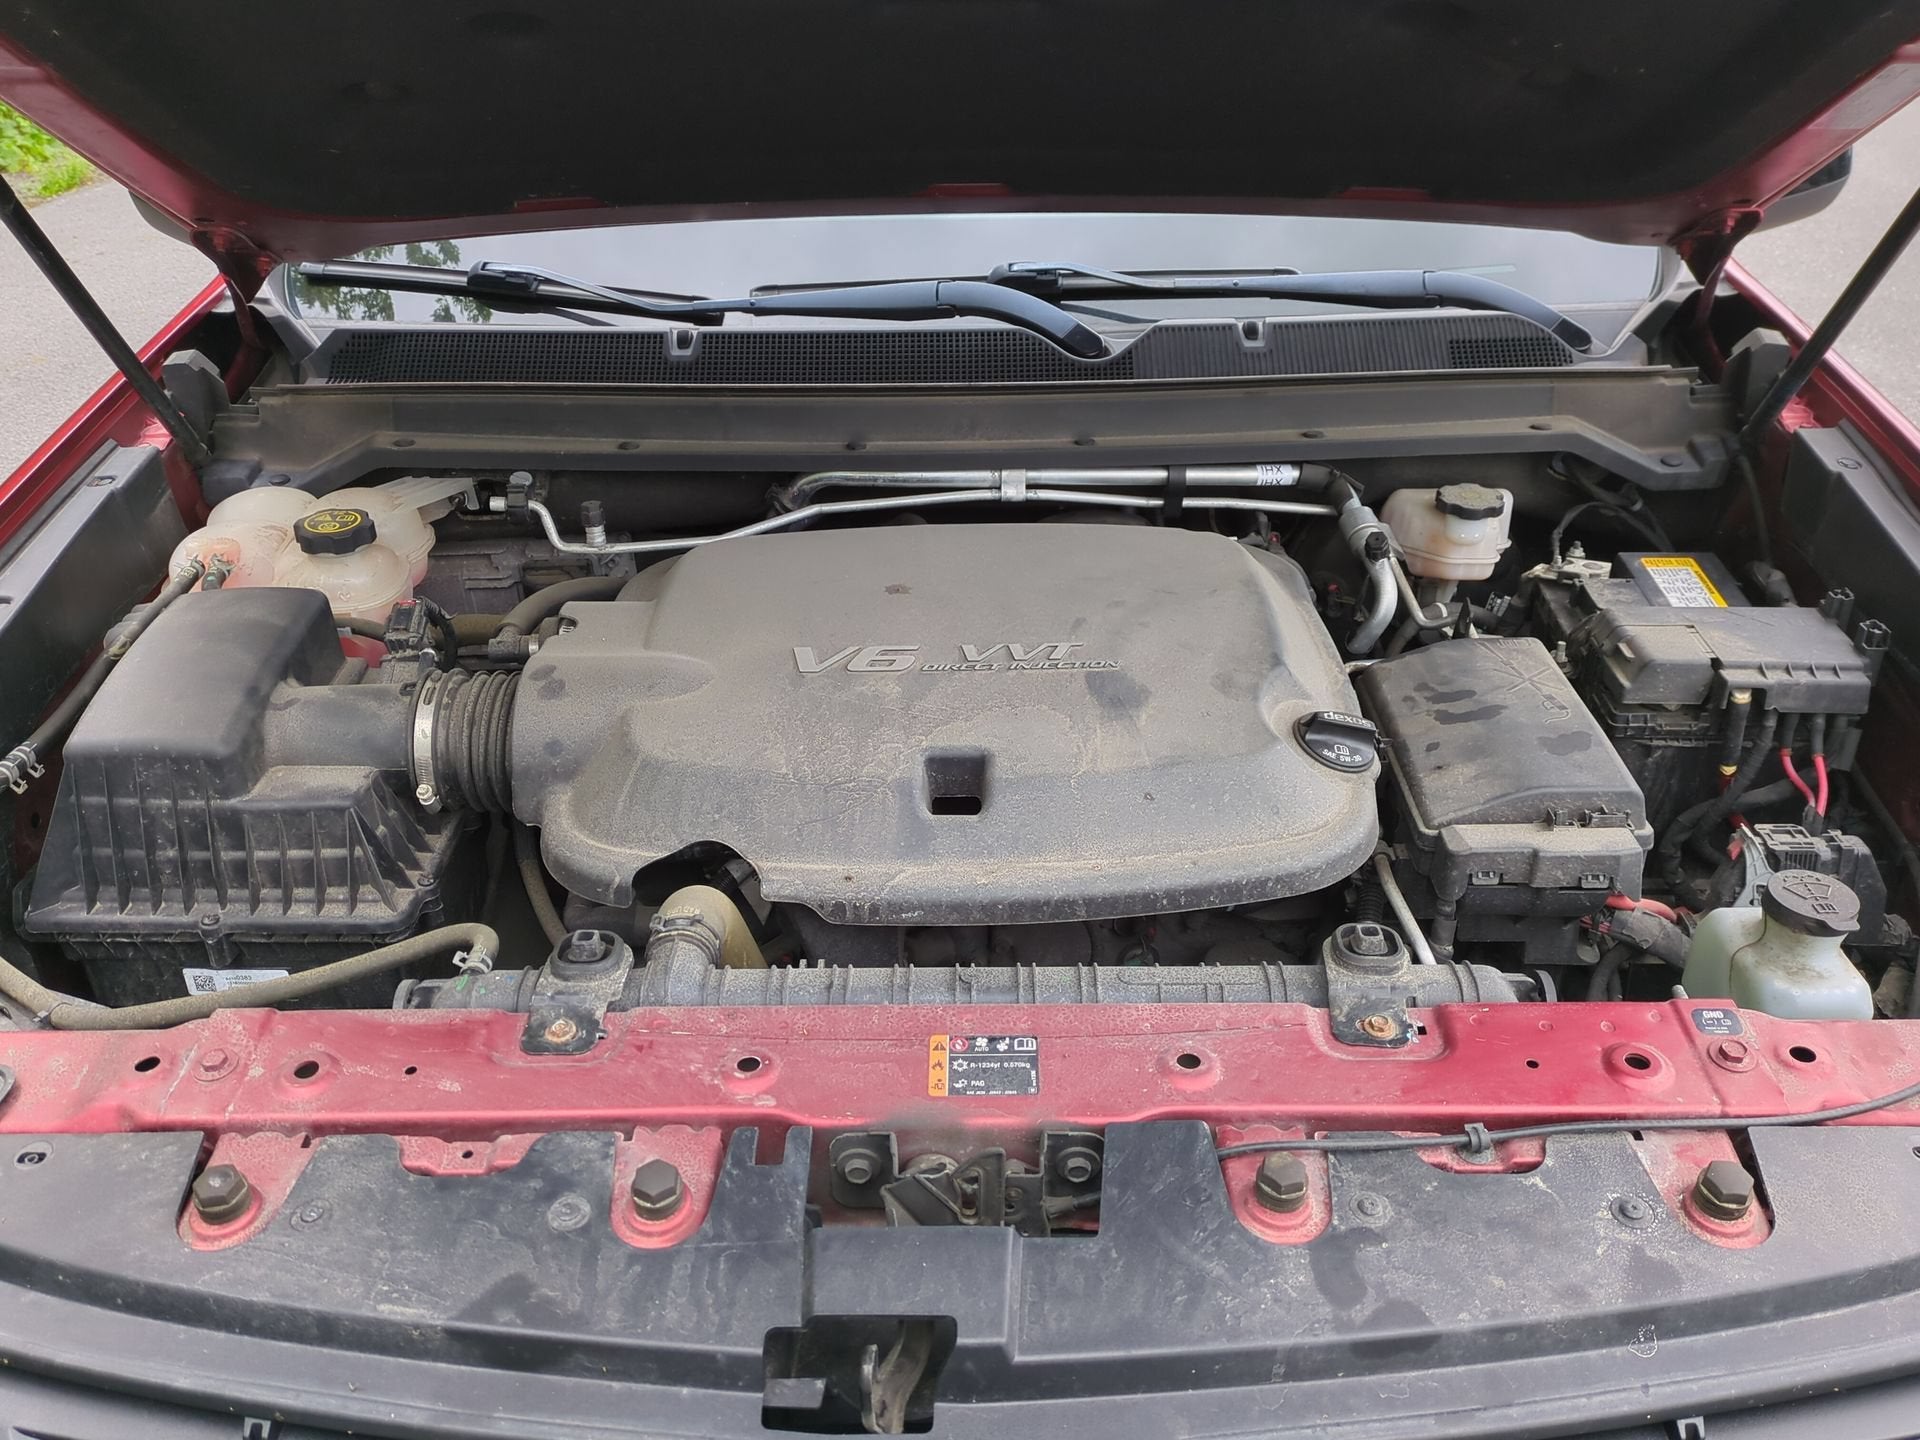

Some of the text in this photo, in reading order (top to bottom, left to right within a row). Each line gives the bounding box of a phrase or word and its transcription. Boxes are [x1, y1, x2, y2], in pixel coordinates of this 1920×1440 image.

[793, 645, 921, 673] V6
[960, 642, 1084, 661] VVT
[920, 660, 1122, 672] DIRECT INJECTION
[1702, 1010, 1724, 1019] GND
